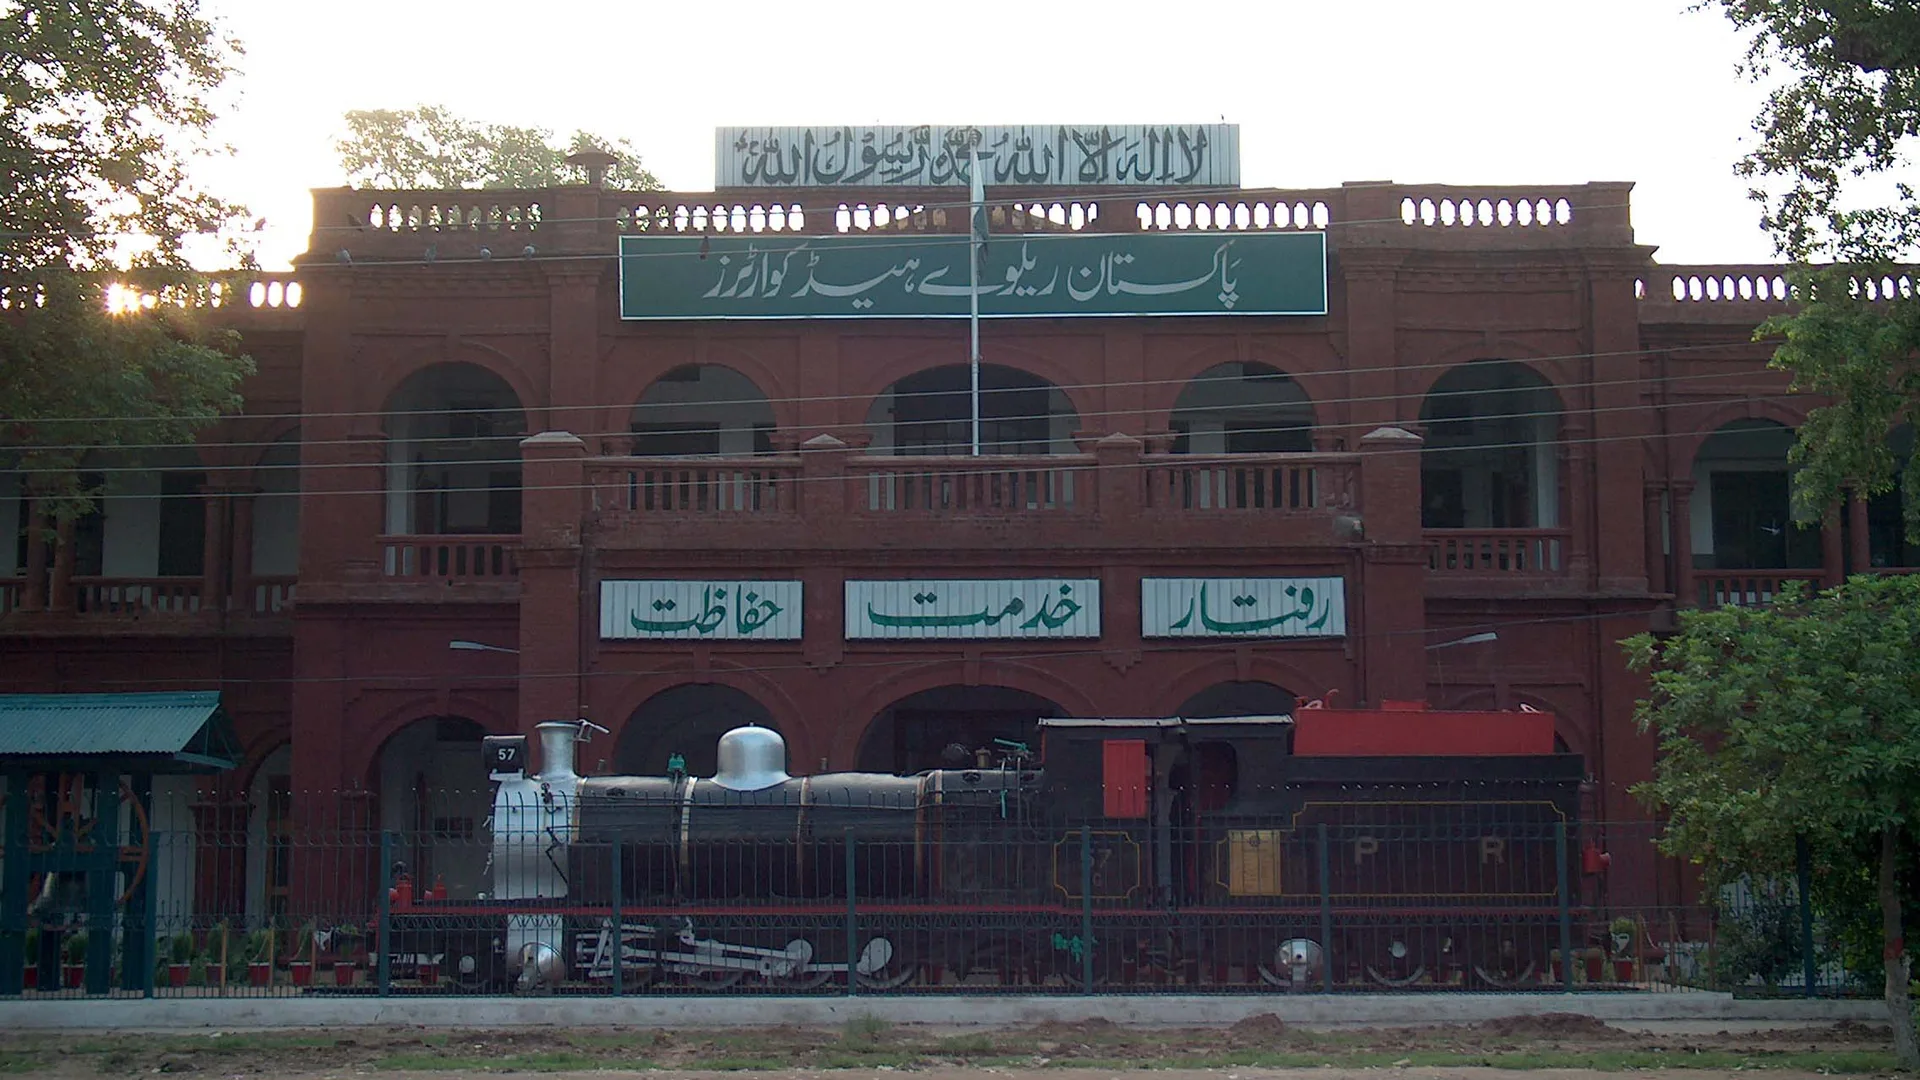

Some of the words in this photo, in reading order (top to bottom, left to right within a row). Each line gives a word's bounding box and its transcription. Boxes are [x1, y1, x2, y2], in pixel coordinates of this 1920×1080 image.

[1067, 239, 1243, 309] پاکستان
[631, 584, 784, 634] حفاظت
[868, 583, 1082, 629] خدمت
[1169, 581, 1329, 632] رفتار
[498, 748, 516, 760] 57
[1354, 836, 1378, 865] P
[1481, 836, 1505, 864] R
